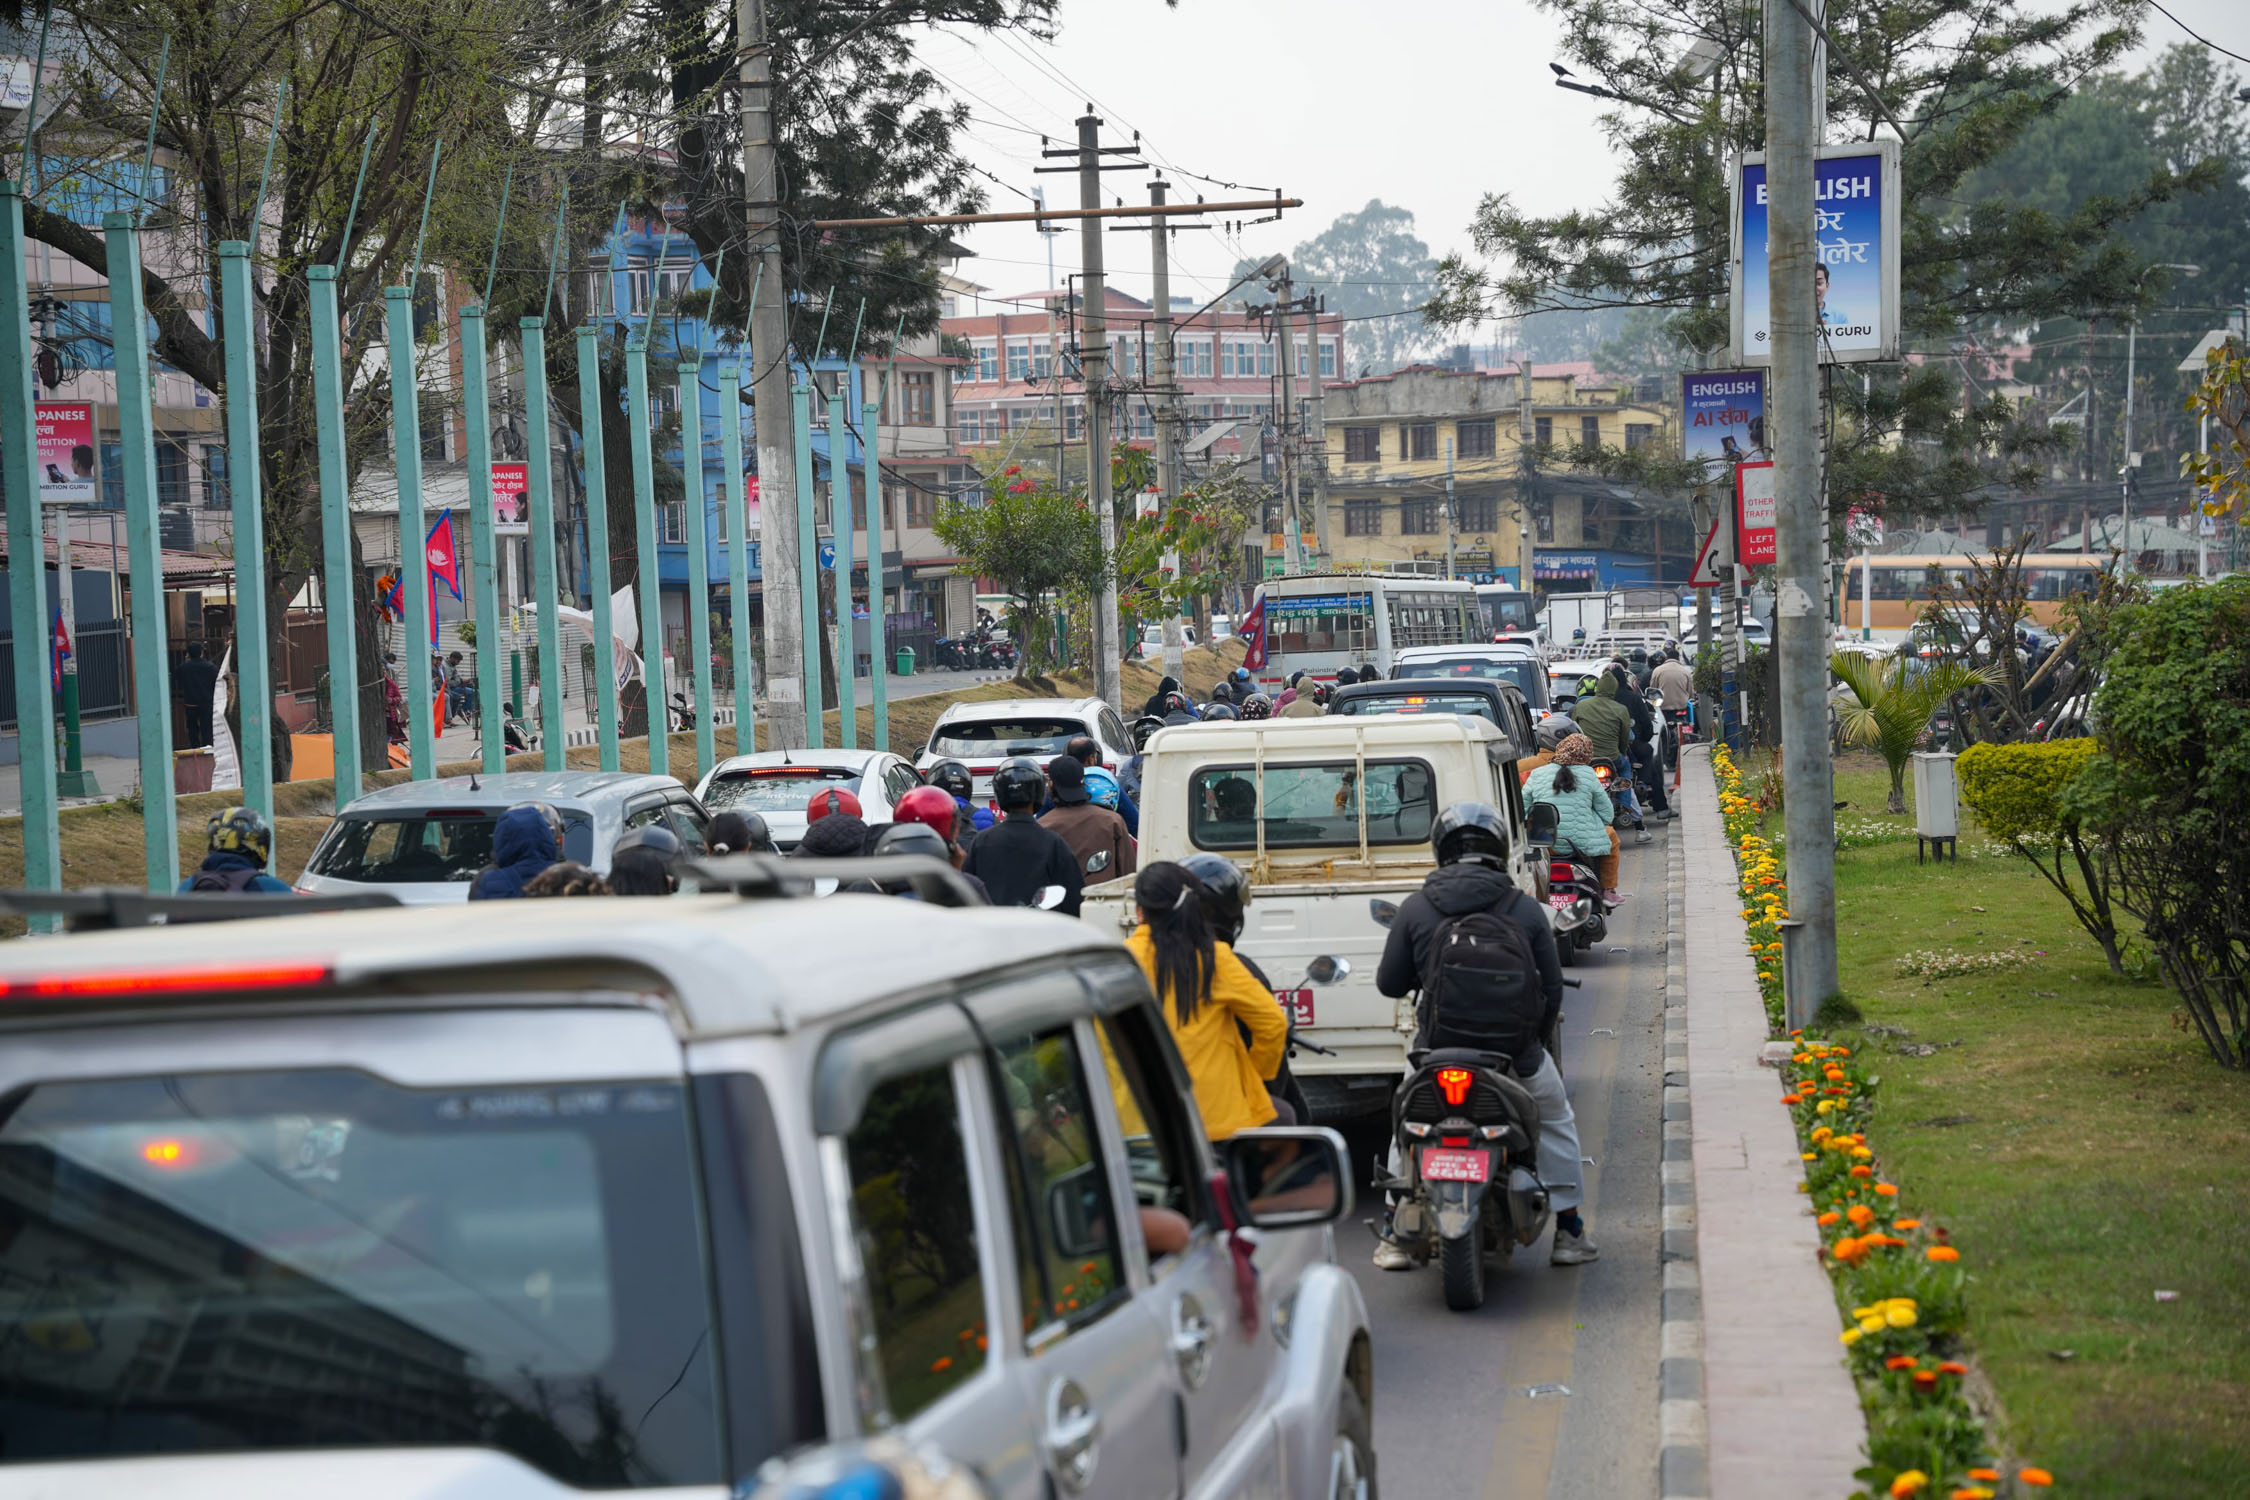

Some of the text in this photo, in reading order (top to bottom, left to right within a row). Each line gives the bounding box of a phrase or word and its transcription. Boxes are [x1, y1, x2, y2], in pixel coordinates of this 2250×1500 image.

[1756, 176, 1871, 205] ELISH
[1835, 326, 1872, 337] GURU
[1692, 381, 1756, 396] ENGLISH
[1693, 411, 1713, 427] AI
[492, 472, 523, 480] APANESE
[1748, 498, 1774, 507] OTHER
[1749, 535, 1773, 544] LEFT
[1750, 546, 1775, 555] LANE
[766, 793, 810, 801] inDrive
